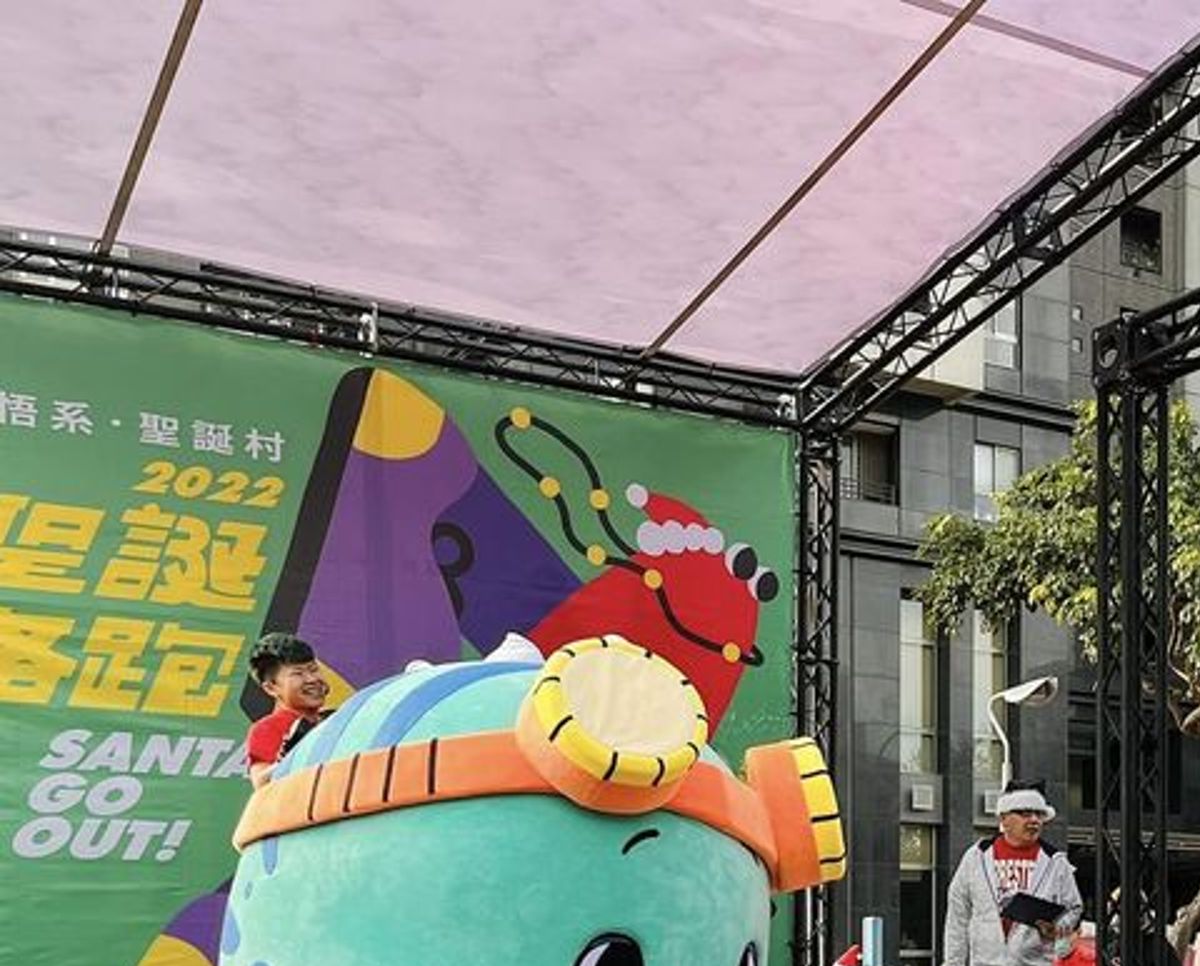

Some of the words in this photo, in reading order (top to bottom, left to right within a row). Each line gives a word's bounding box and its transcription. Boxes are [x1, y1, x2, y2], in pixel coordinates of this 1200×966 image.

[132, 461, 285, 508] 2022
[28, 772, 143, 815] GO
[12, 816, 193, 862] OUT!
